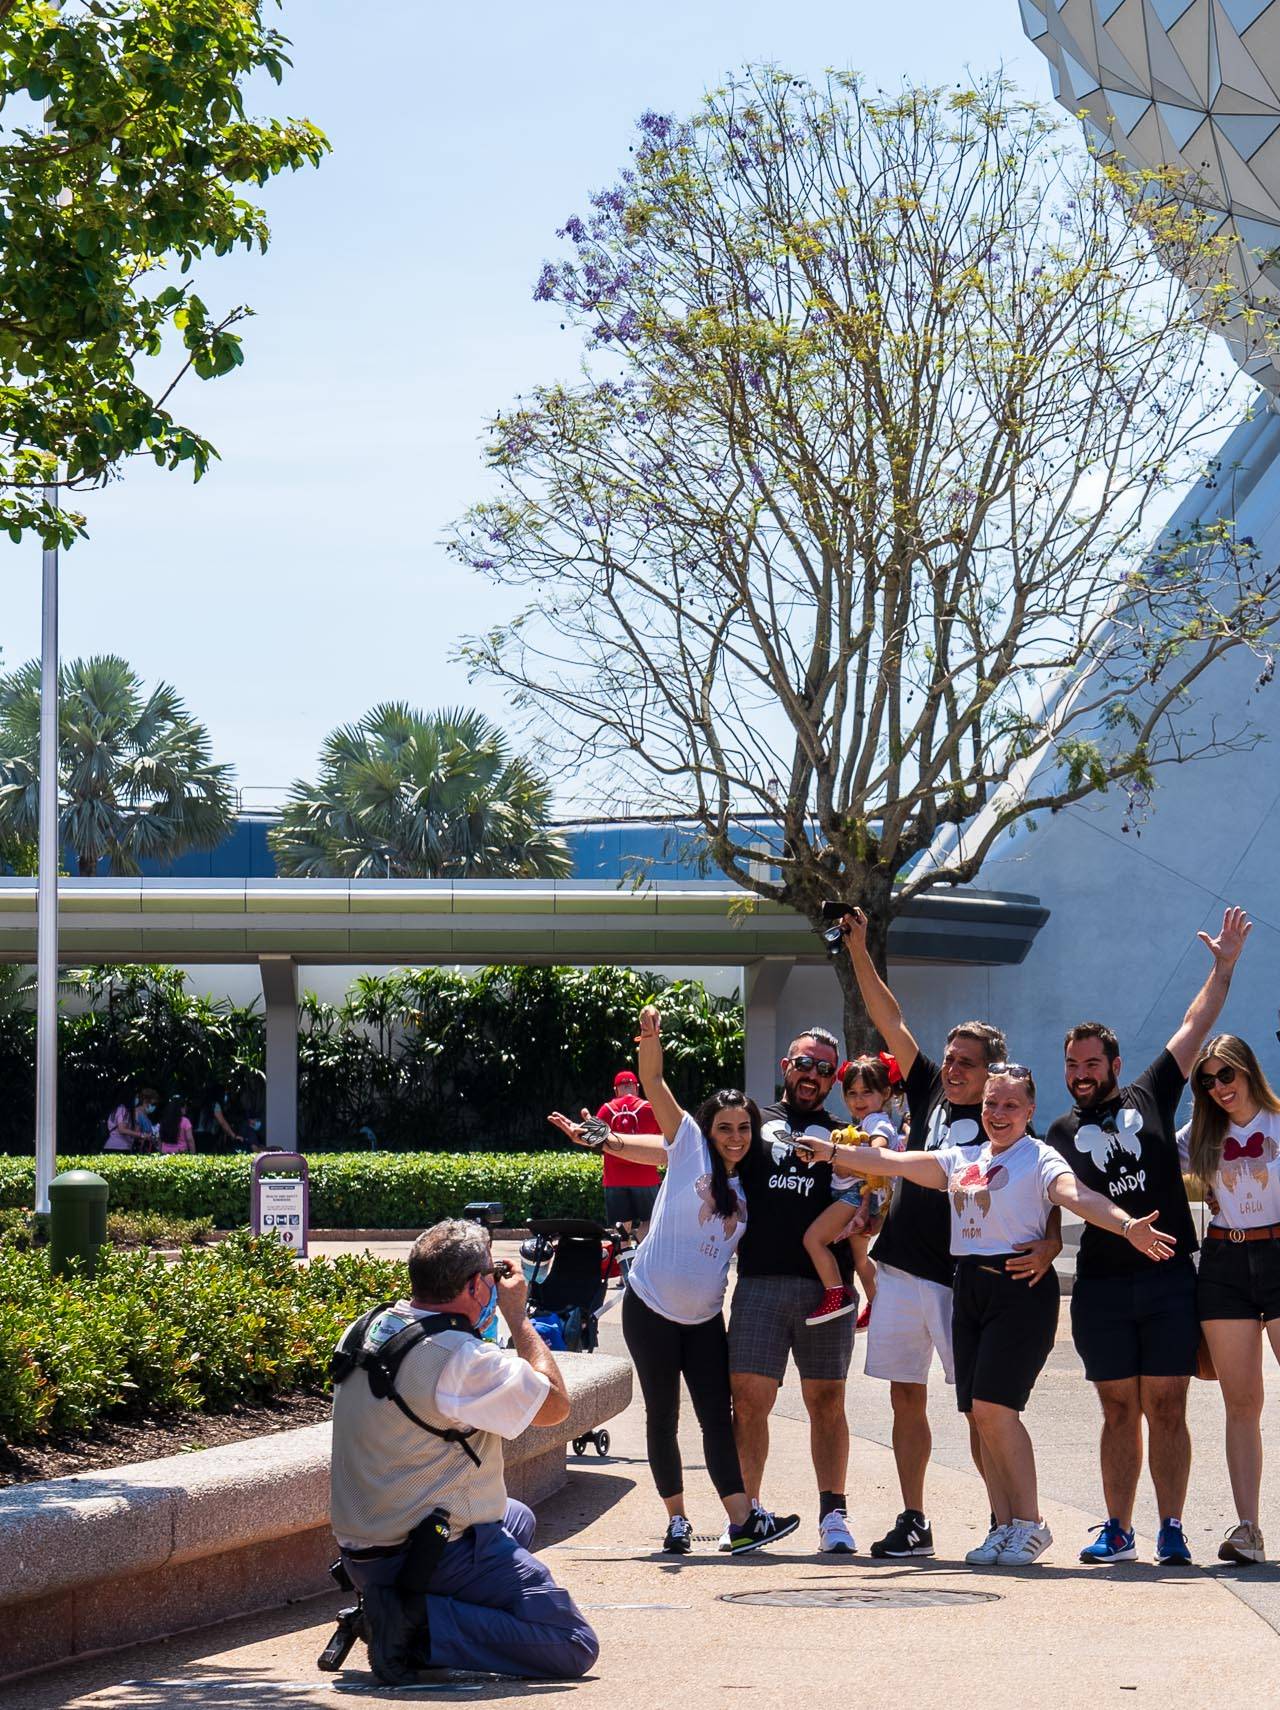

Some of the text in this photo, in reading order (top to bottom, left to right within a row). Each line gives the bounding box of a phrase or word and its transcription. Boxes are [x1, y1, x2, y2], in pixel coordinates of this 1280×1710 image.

[768, 1174, 815, 1197] GUSTY
[1109, 1169, 1146, 1197] ANDY
[1240, 1201, 1263, 1214] LALU
[962, 1227, 982, 1239] MOM
